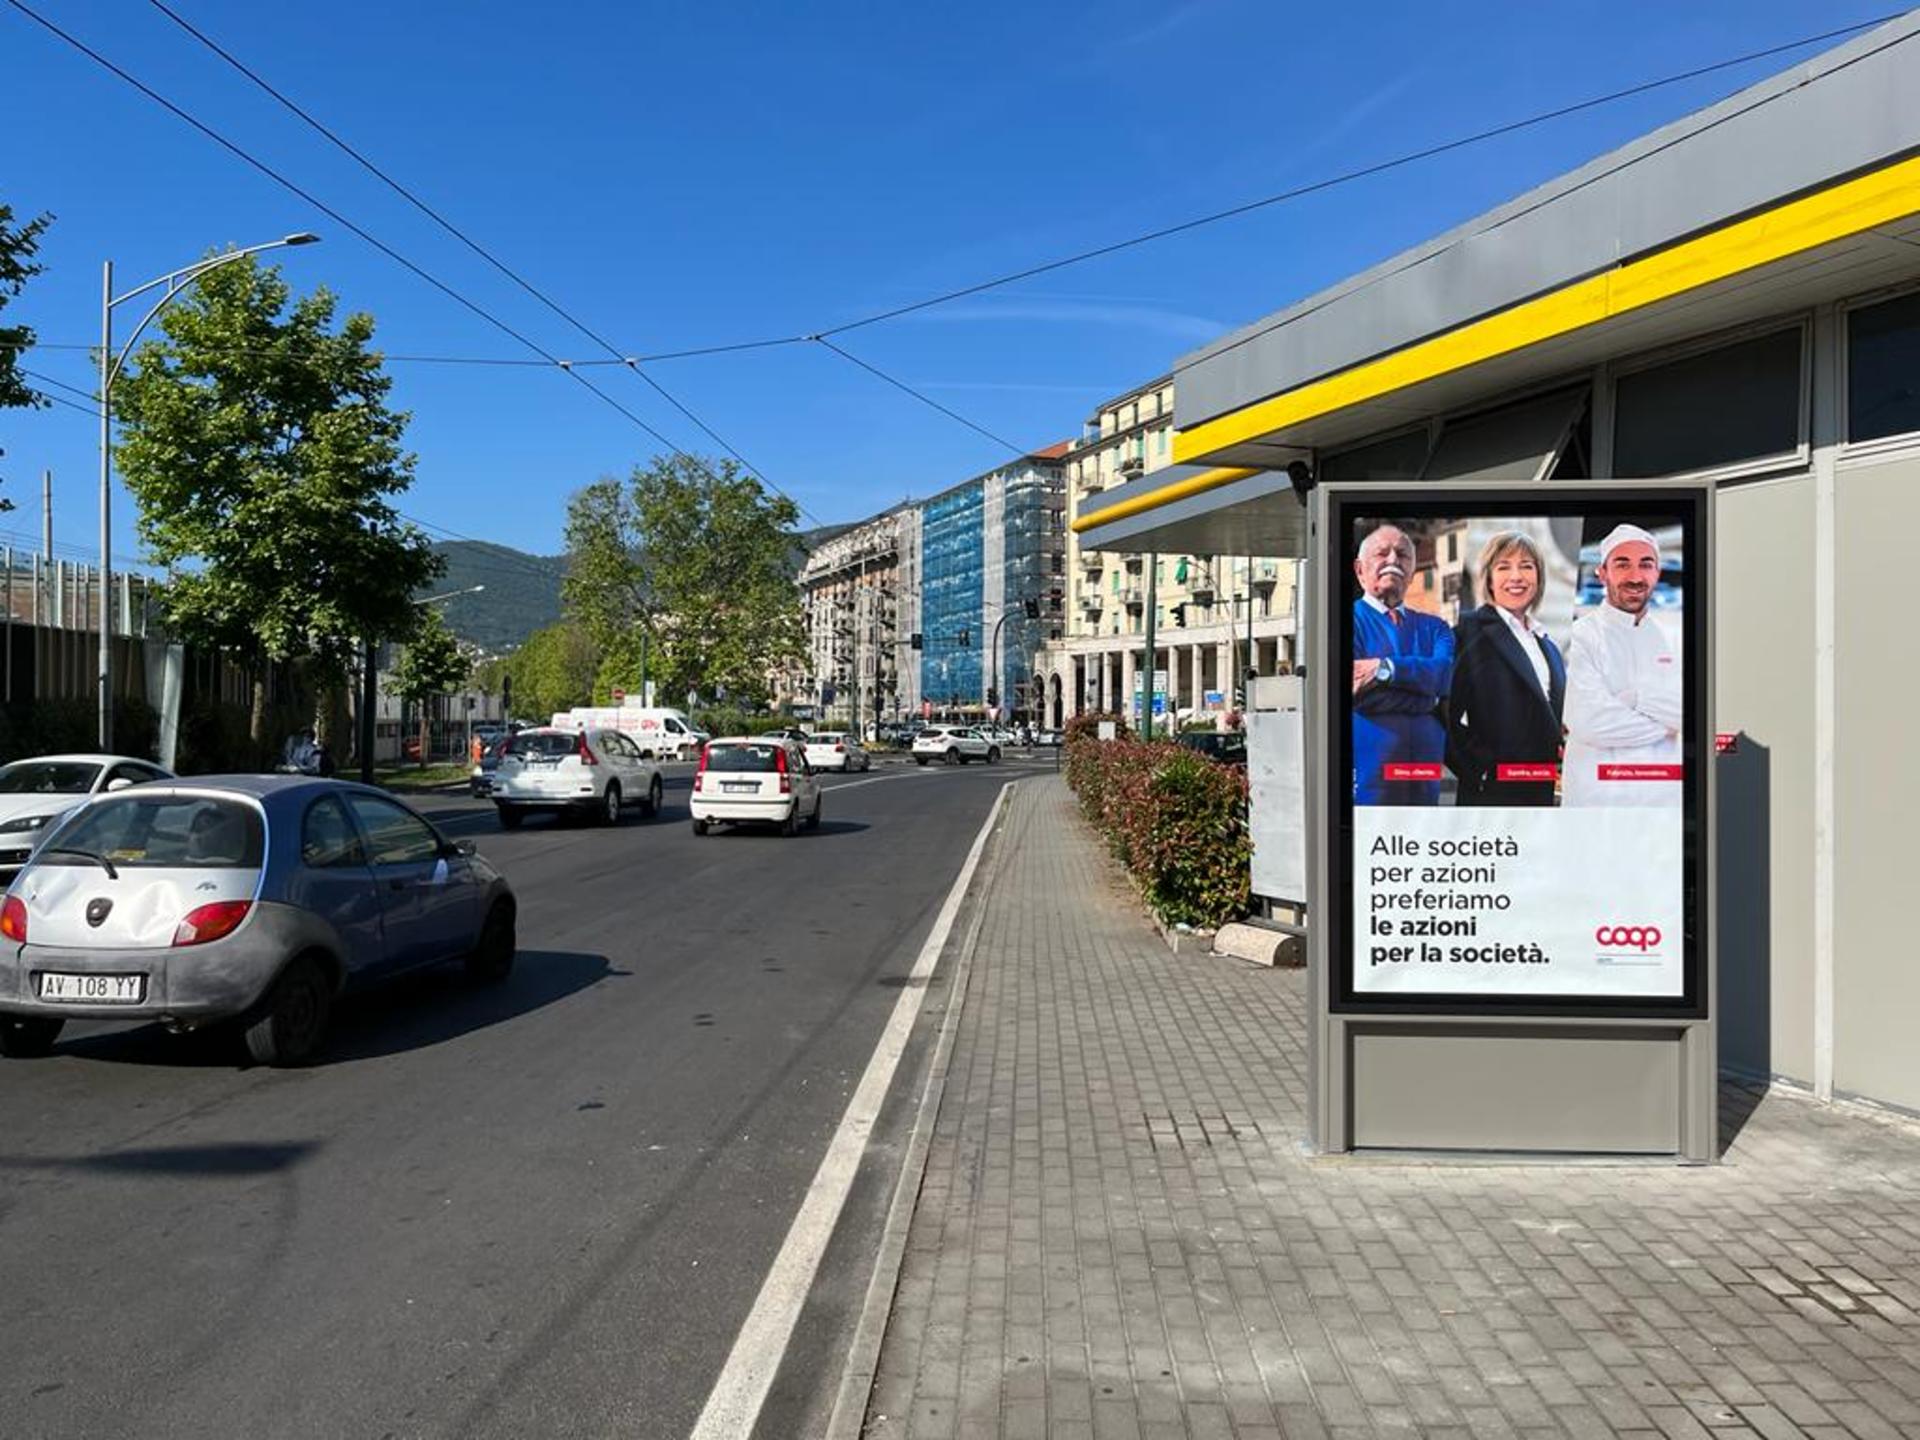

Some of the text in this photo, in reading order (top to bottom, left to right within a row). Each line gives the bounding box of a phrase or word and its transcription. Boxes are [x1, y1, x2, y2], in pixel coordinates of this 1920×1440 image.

[1370, 835, 1519, 857] Alle società
[1370, 862, 1496, 886] per azioni
[1370, 889, 1512, 913] preferiamo
[1370, 915, 1477, 937] le azioni
[1596, 926, 1662, 951] coop
[1370, 942, 1551, 967] per la società.
[44, 976, 136, 996] AV 108 YY
